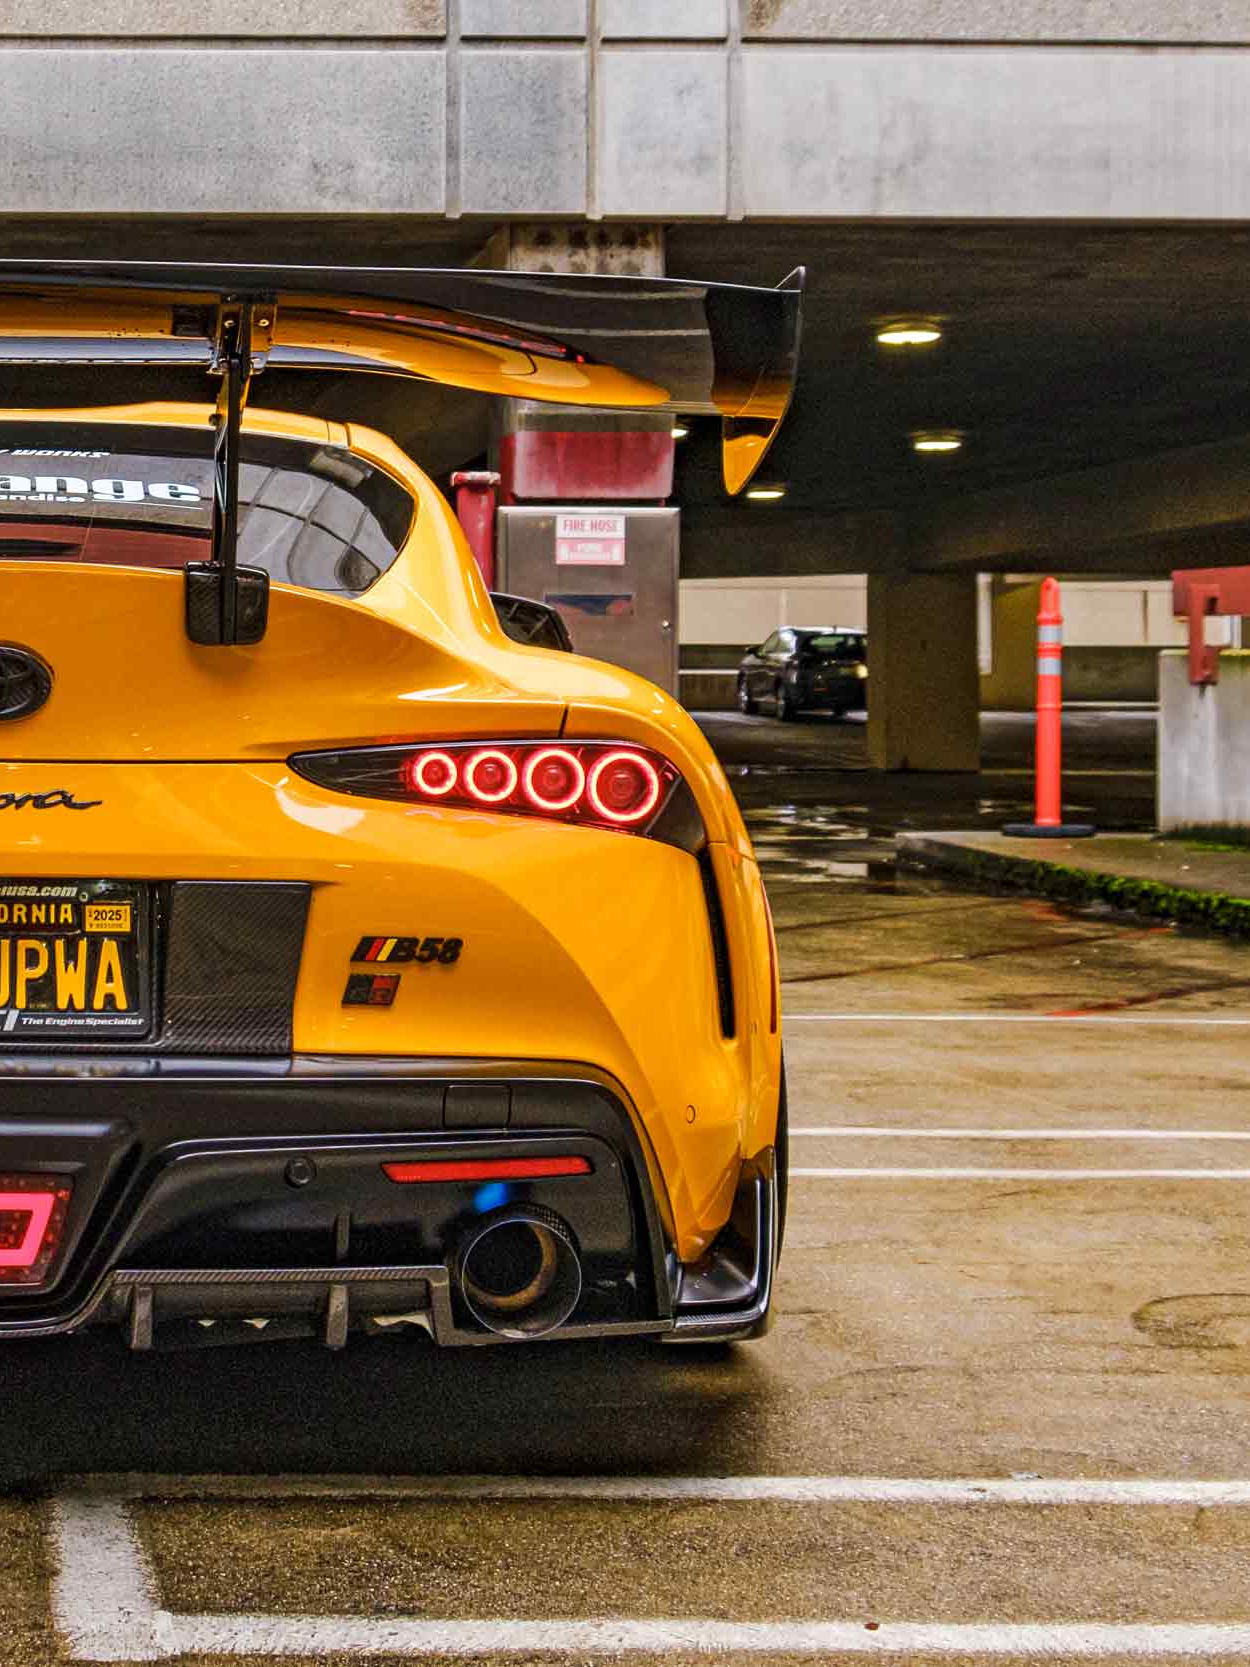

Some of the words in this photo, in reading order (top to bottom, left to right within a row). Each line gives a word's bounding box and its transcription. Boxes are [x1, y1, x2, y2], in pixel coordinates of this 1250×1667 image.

[563, 519, 585, 532] FIRE
[590, 519, 618, 532] HOSE
[93, 909, 122, 921] 2025
[390, 936, 463, 964] B58
[21, 1016, 44, 1026] The
[44, 1016, 85, 1026] Engine
[85, 1016, 145, 1026] Specialist
